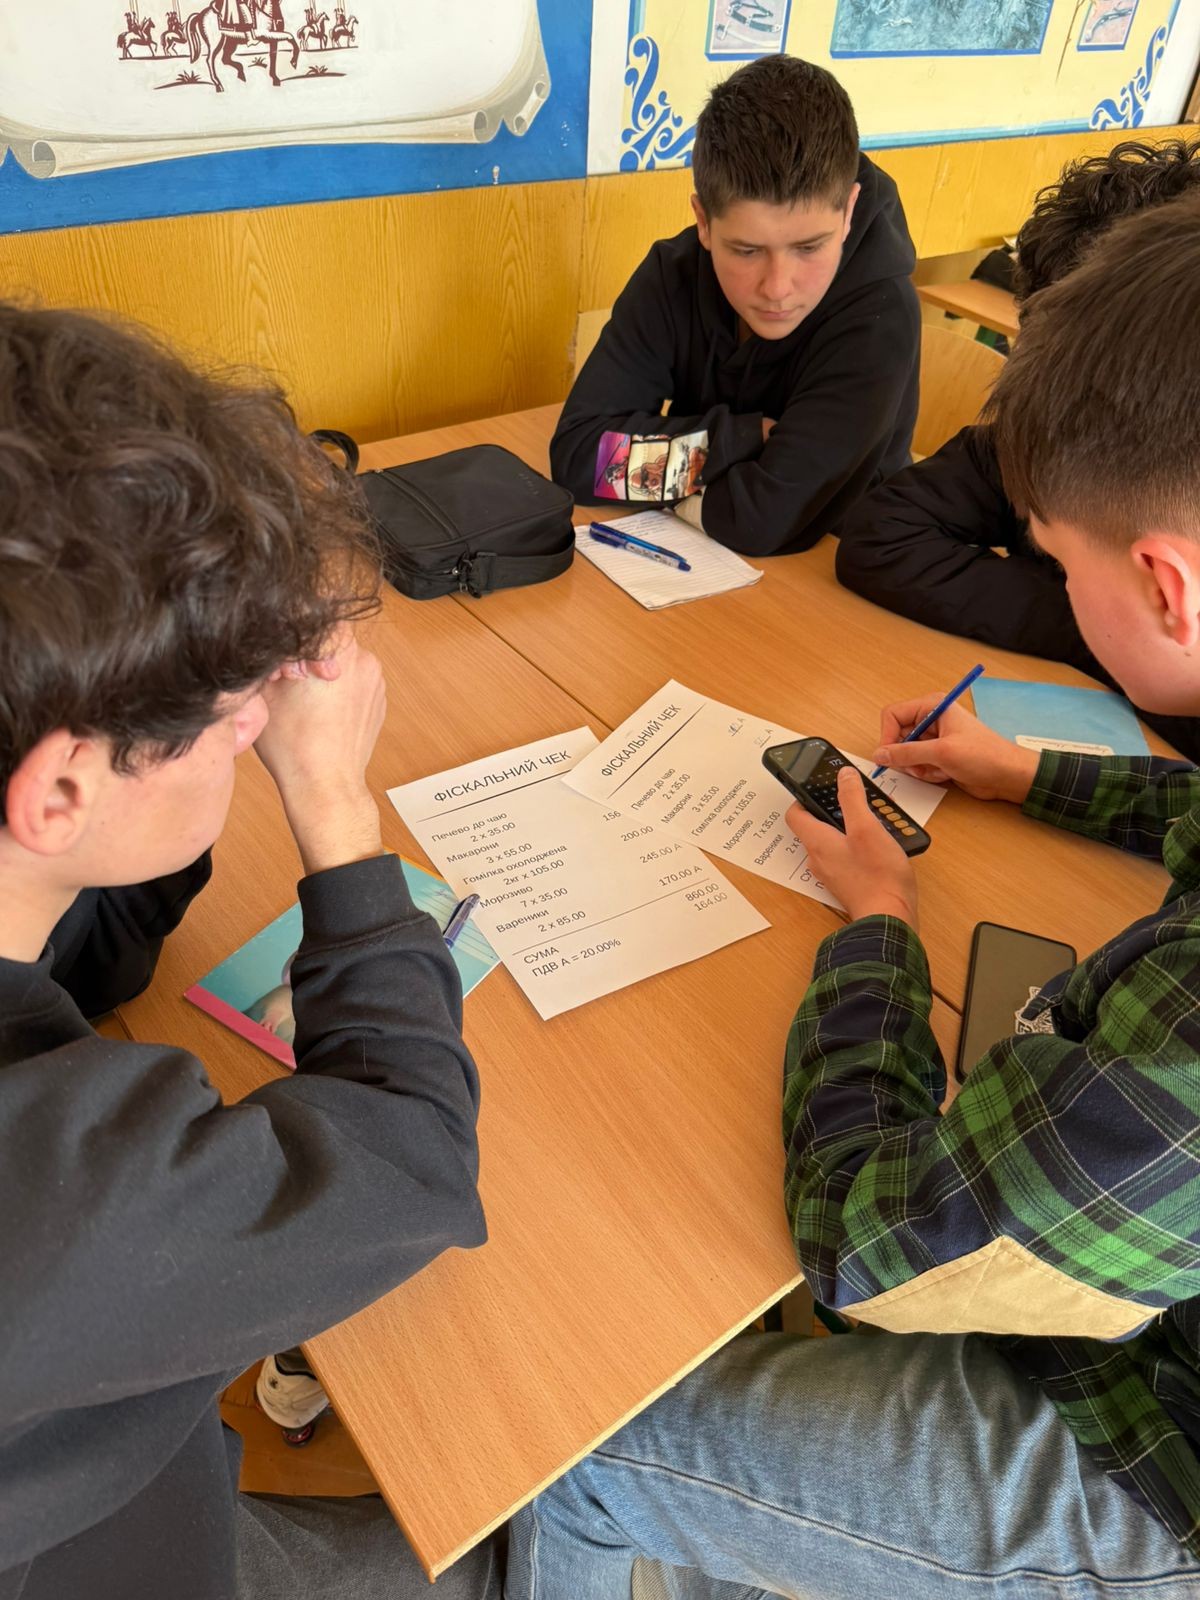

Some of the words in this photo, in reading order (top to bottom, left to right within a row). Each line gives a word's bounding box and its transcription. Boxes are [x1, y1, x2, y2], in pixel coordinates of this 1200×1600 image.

[601, 720, 664, 777] ФІСКАЛЬНИЙ
[657, 704, 681, 722] ЧЕК
[434, 759, 538, 802] ФІСКАЛЬНИЙ
[539, 750, 572, 766] ЧЕК
[631, 788, 657, 811] Печево
[656, 779, 665, 790] до
[662, 768, 676, 781] чаю
[662, 793, 671, 801] 2
[671, 773, 691, 791] 35.00
[661, 793, 693, 824] Макарони
[701, 785, 720, 803] 55.00
[736, 791, 757, 811] 105.00
[432, 825, 470, 842] Печево
[472, 820, 485, 831] до
[487, 812, 508, 824] чаю
[470, 835, 479, 843] 2
[488, 821, 516, 837] 35.00
[722, 819, 754, 851] Морозиво
[762, 811, 781, 829] 35.00
[446, 841, 499, 863] Макарони
[486, 856, 494, 864] 3
[504, 842, 532, 858] 55.00
[602, 810, 621, 822] 156
[754, 834, 784, 866] Вареники
[785, 846, 795, 854] 2
[462, 867, 505, 885] Гомілка
[506, 844, 567, 871] охолоджена
[503, 875, 519, 886] 2кг
[532, 859, 565, 877] 105.00
[620, 825, 654, 842] 200.00
[520, 900, 528, 908] 7
[540, 887, 568, 902] 35.00
[639, 846, 673, 863] 245.00
[479, 885, 533, 909] Морозиво
[538, 924, 547, 933] 2
[556, 910, 586, 926] 85.00
[659, 868, 692, 886] 170.00
[495, 909, 550, 933] Вареники
[523, 946, 560, 964] СУМА
[685, 882, 719, 901] 860.00
[532, 961, 559, 977] ПДВ
[580, 938, 621, 958] 20.00%
[693, 892, 728, 912] 164.00
